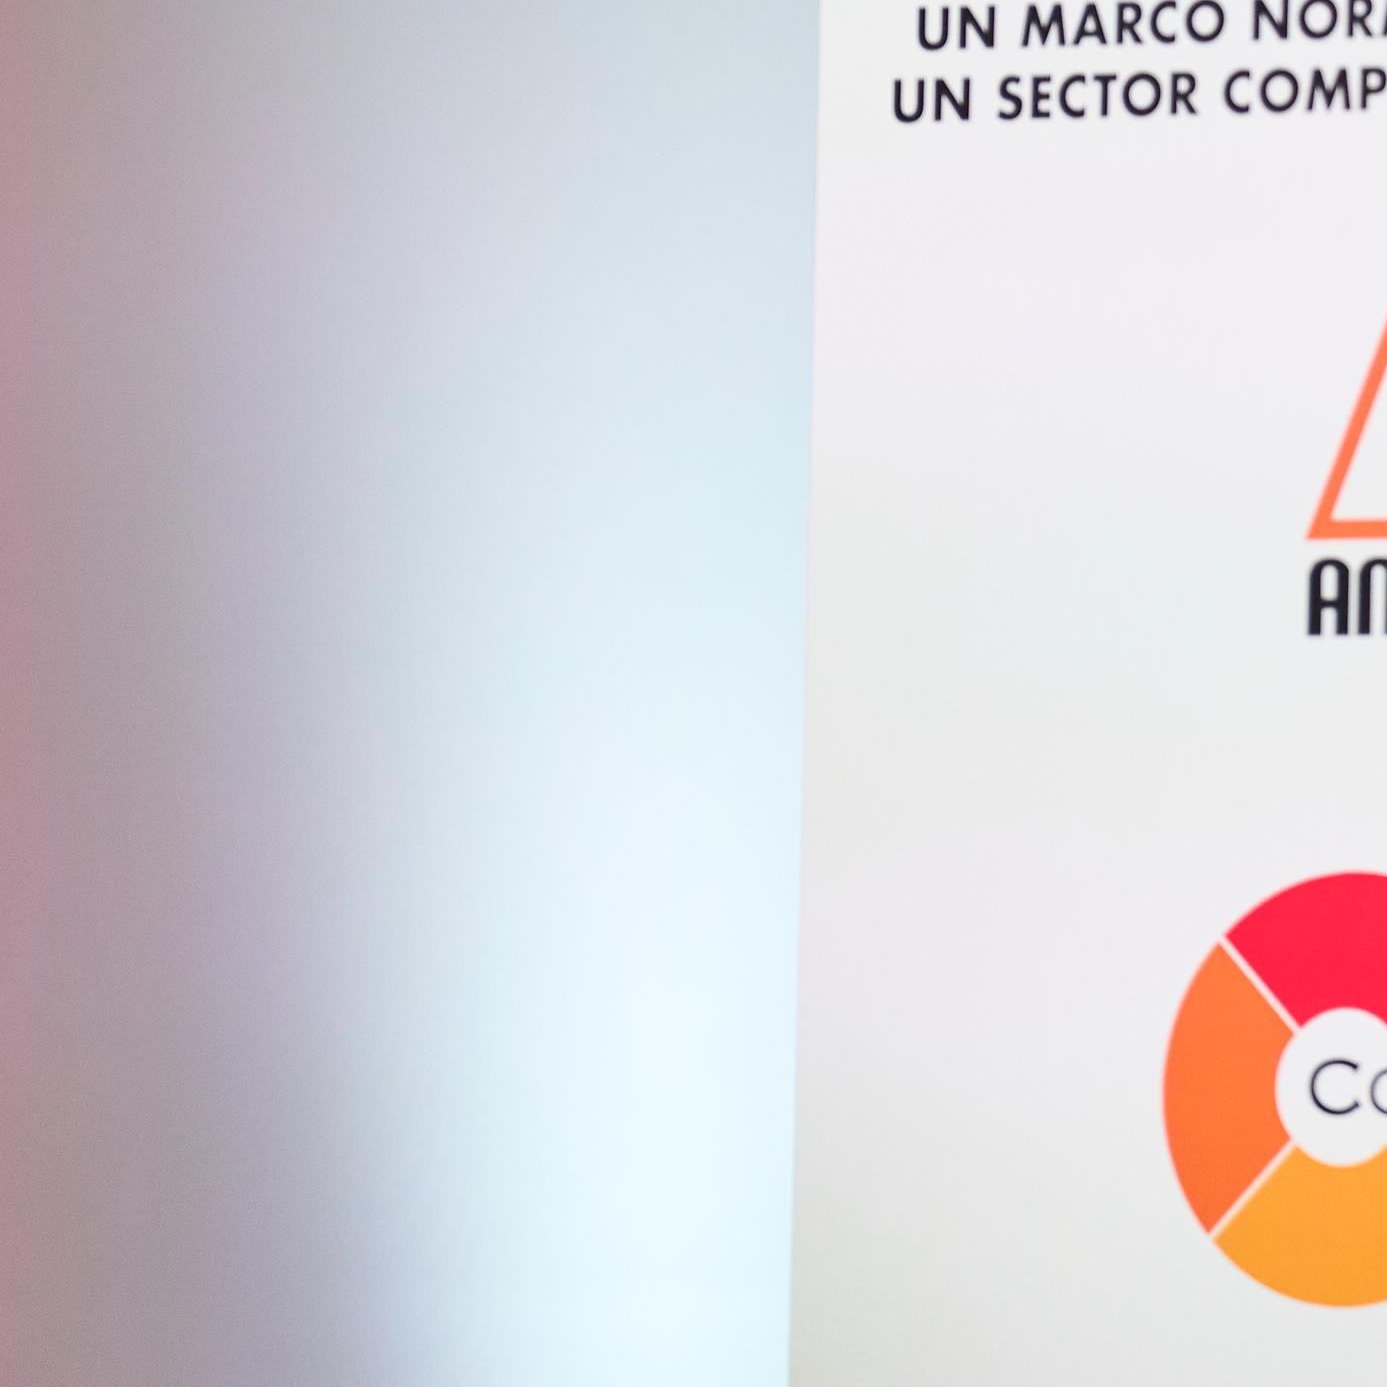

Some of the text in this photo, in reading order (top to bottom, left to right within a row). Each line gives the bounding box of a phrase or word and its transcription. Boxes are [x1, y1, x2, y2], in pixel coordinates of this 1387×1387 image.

[916, 3, 997, 52] UN
[892, 75, 972, 124] UN
[996, 70, 1198, 121] SECTOR
